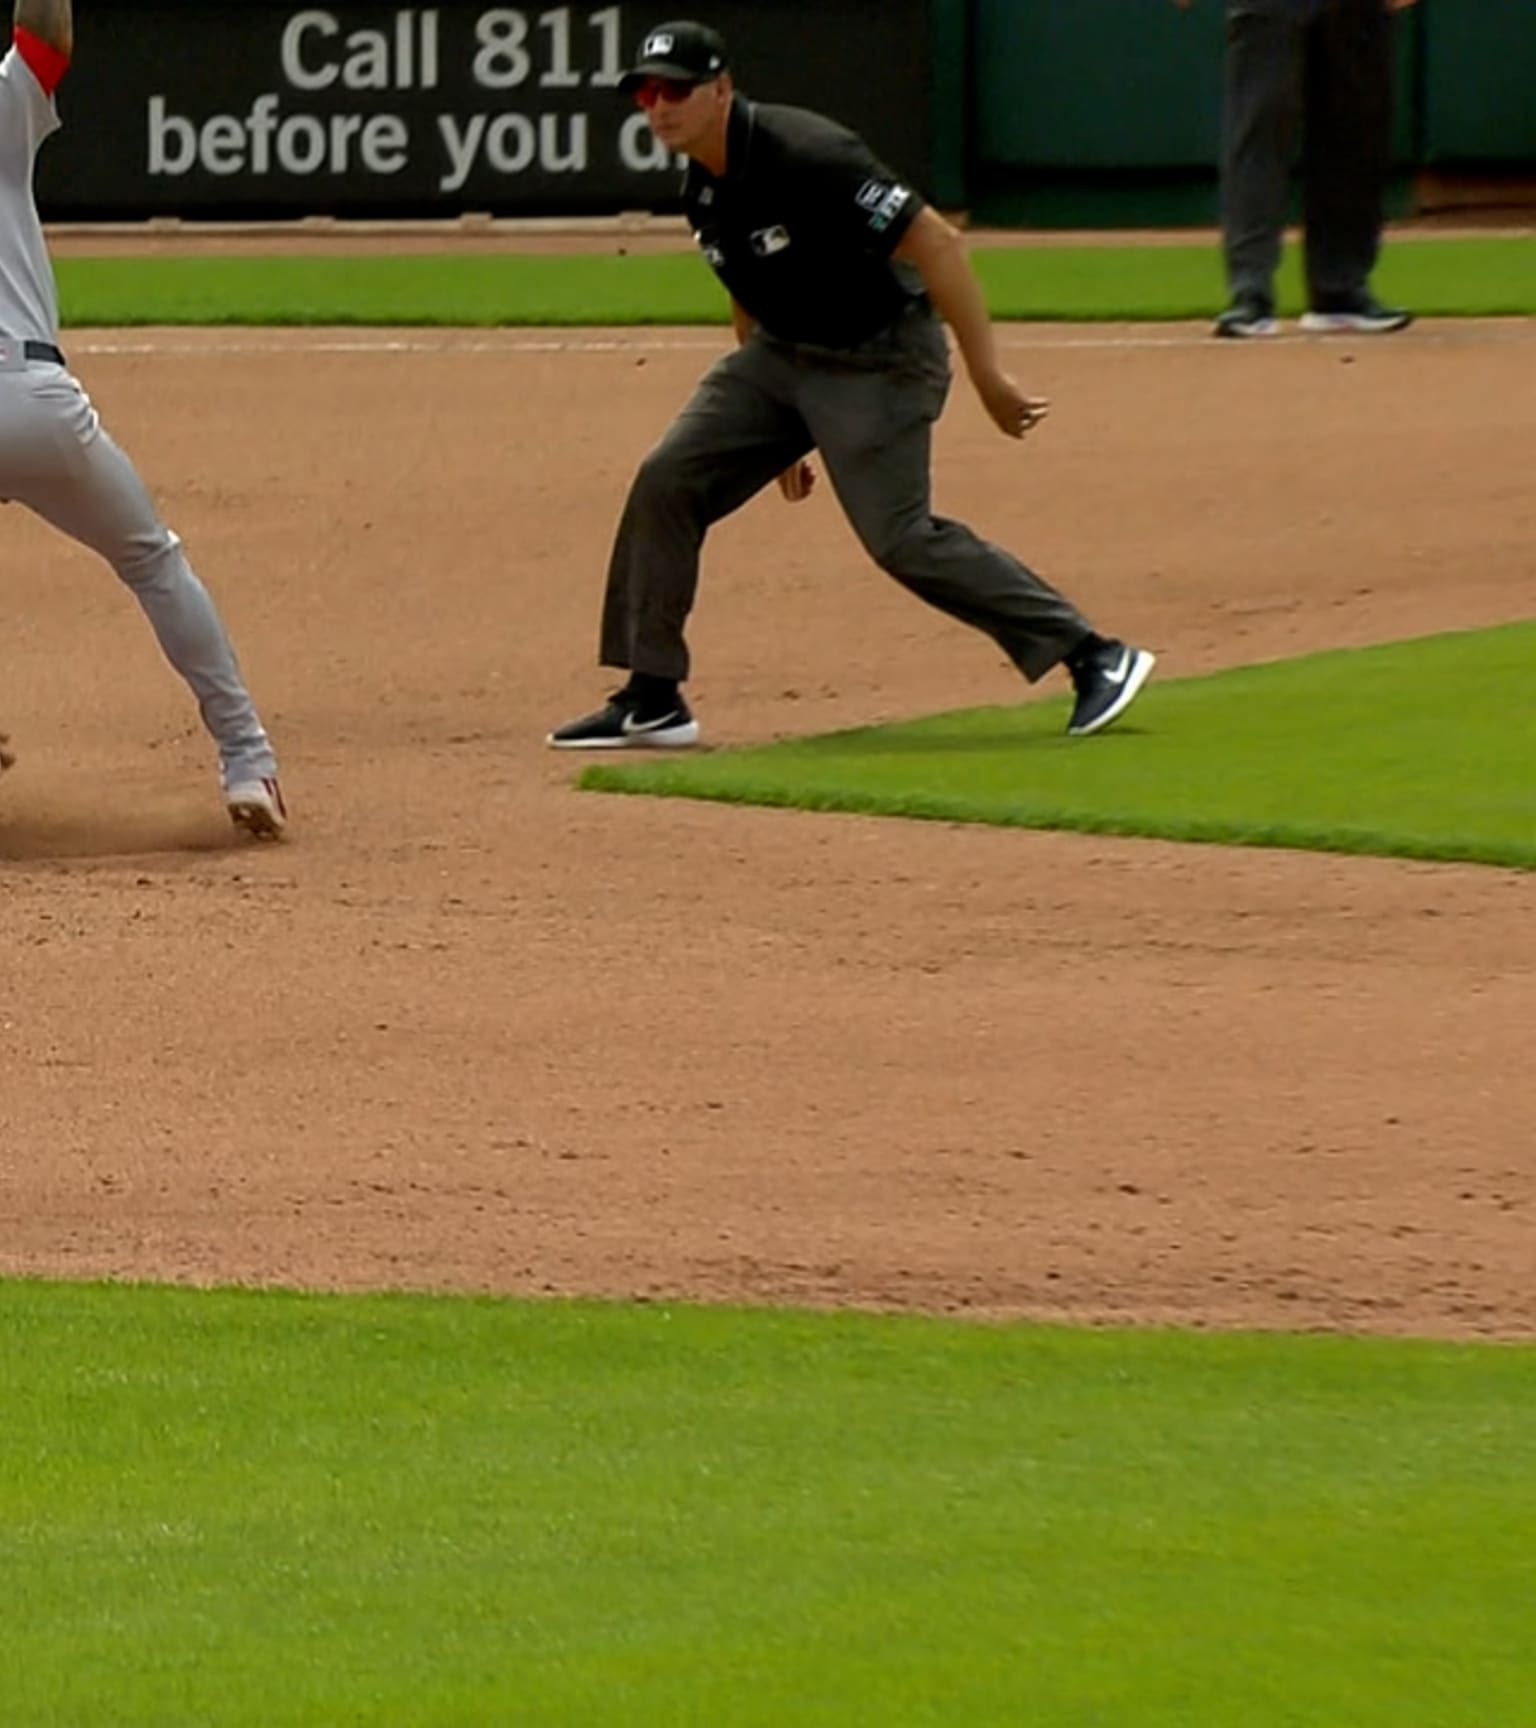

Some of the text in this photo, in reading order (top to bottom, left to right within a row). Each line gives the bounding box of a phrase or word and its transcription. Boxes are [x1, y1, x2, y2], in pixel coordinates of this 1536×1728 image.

[281, 6, 624, 90] Call 811
[147, 94, 408, 175] before
[439, 112, 587, 192] you
